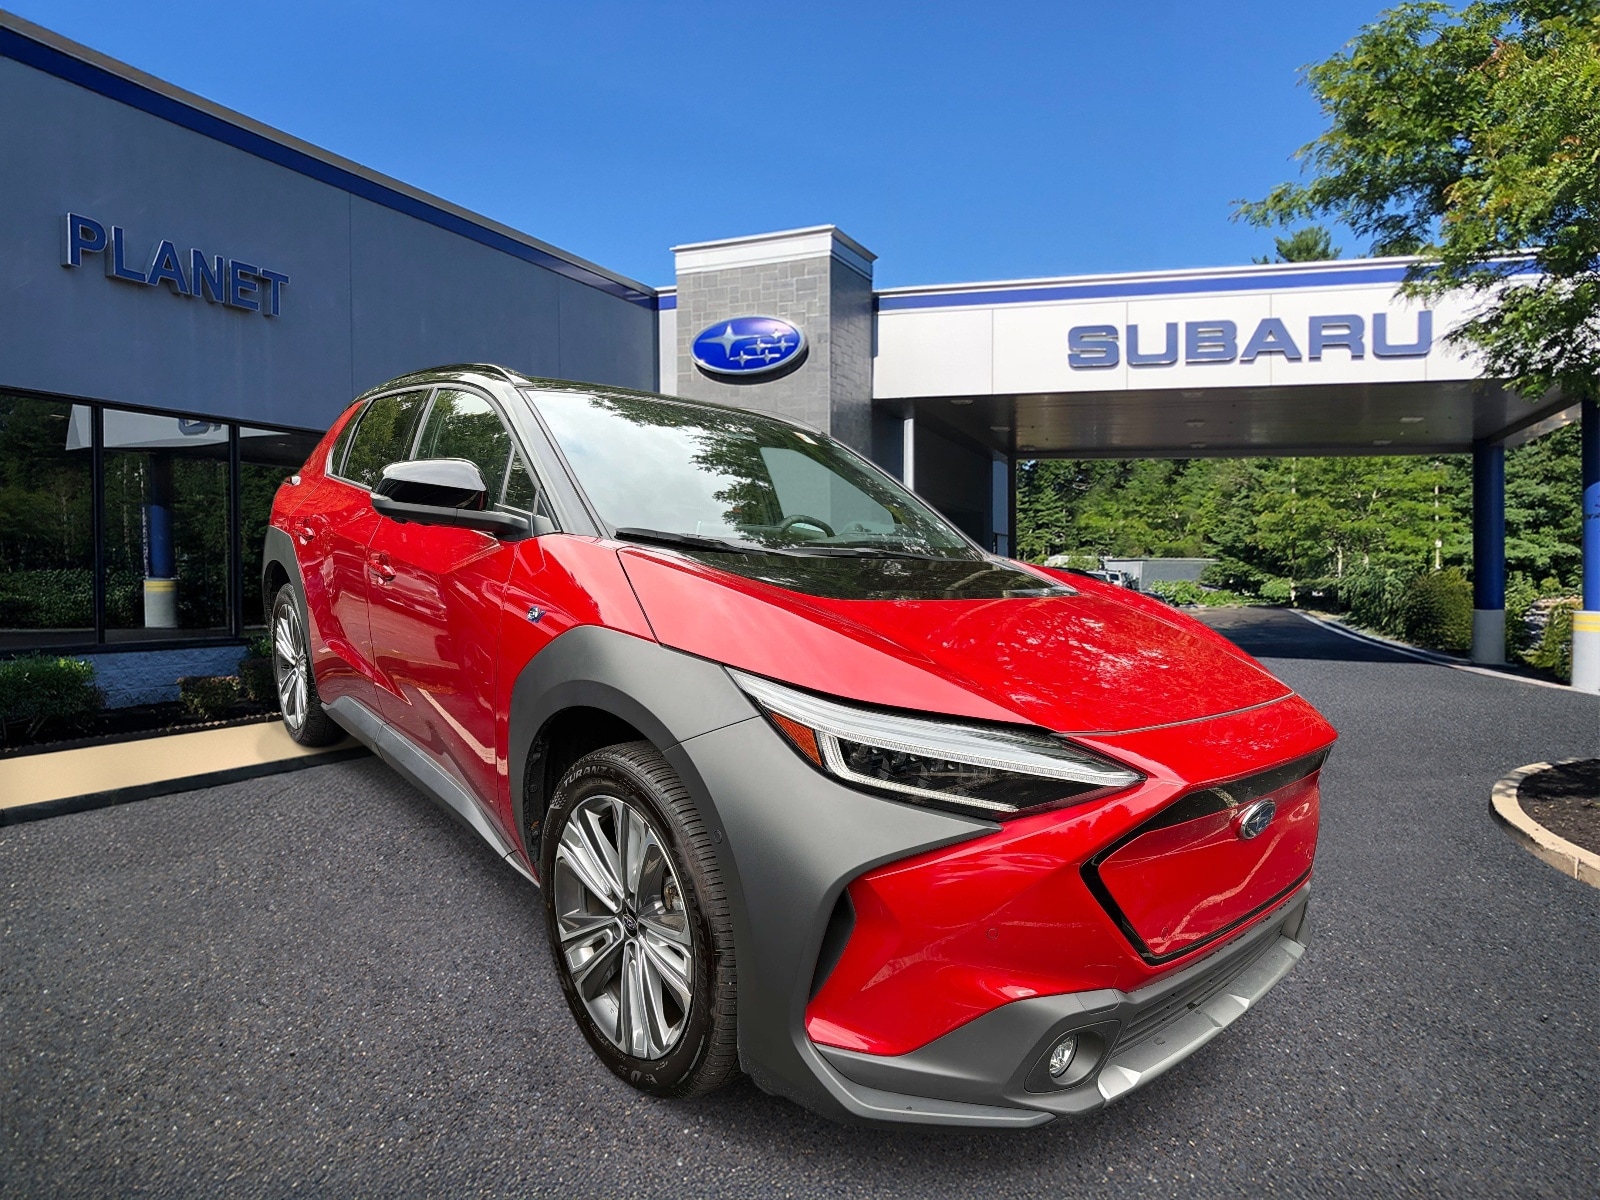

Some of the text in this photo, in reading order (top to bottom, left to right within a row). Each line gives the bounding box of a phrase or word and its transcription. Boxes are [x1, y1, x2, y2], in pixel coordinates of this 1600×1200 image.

[62, 212, 290, 317] PLANET
[1067, 310, 1433, 369] SUBARU
[563, 765, 617, 788] TURANZA
